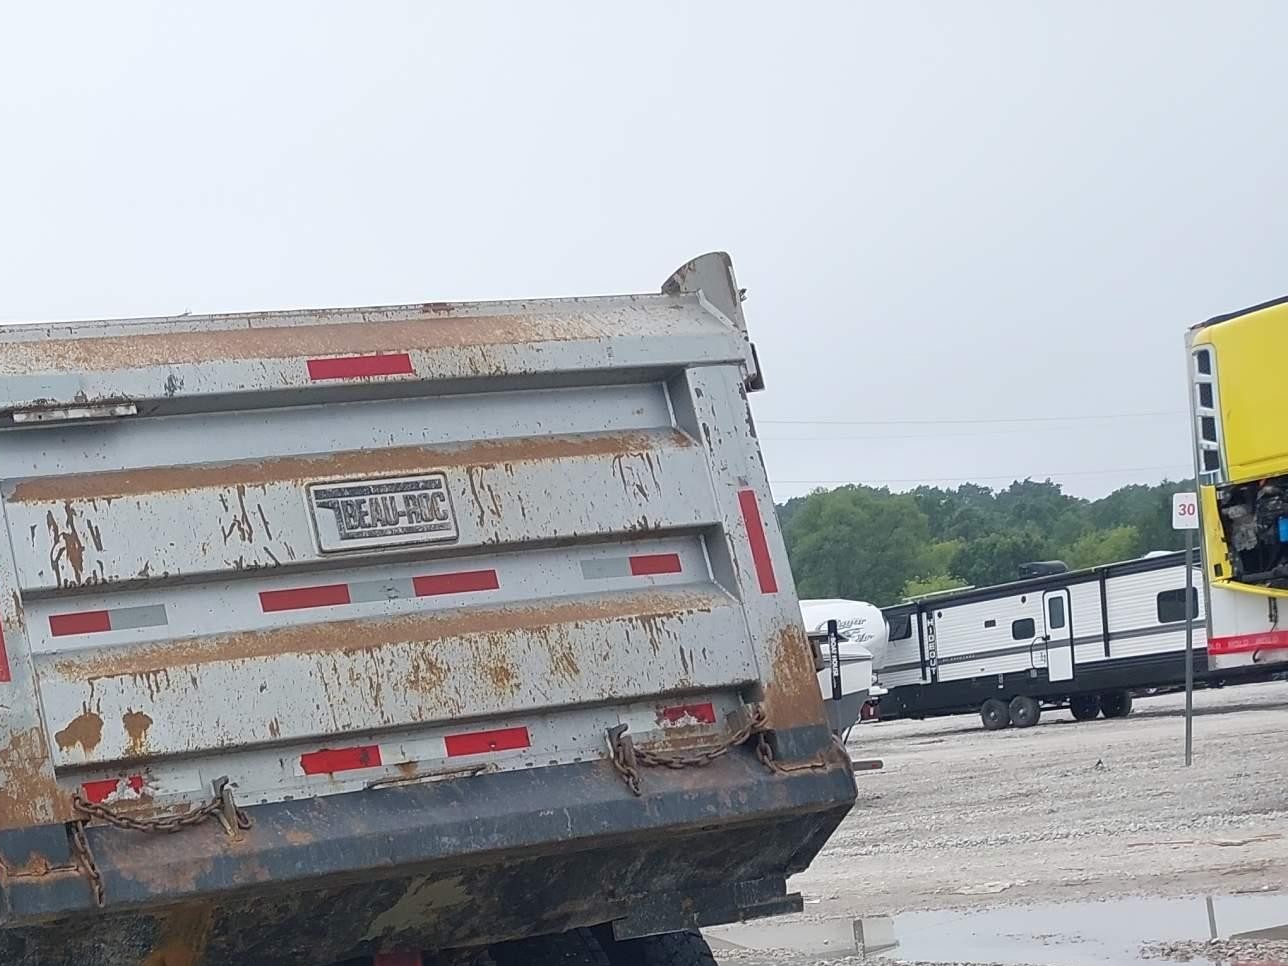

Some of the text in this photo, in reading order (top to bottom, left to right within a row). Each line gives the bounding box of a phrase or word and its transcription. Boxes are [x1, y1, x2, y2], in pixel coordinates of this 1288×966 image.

[340, 491, 449, 530] BEAU-ROC
[1178, 503, 1196, 516] 30
[927, 618, 937, 675] HIDEOUT
